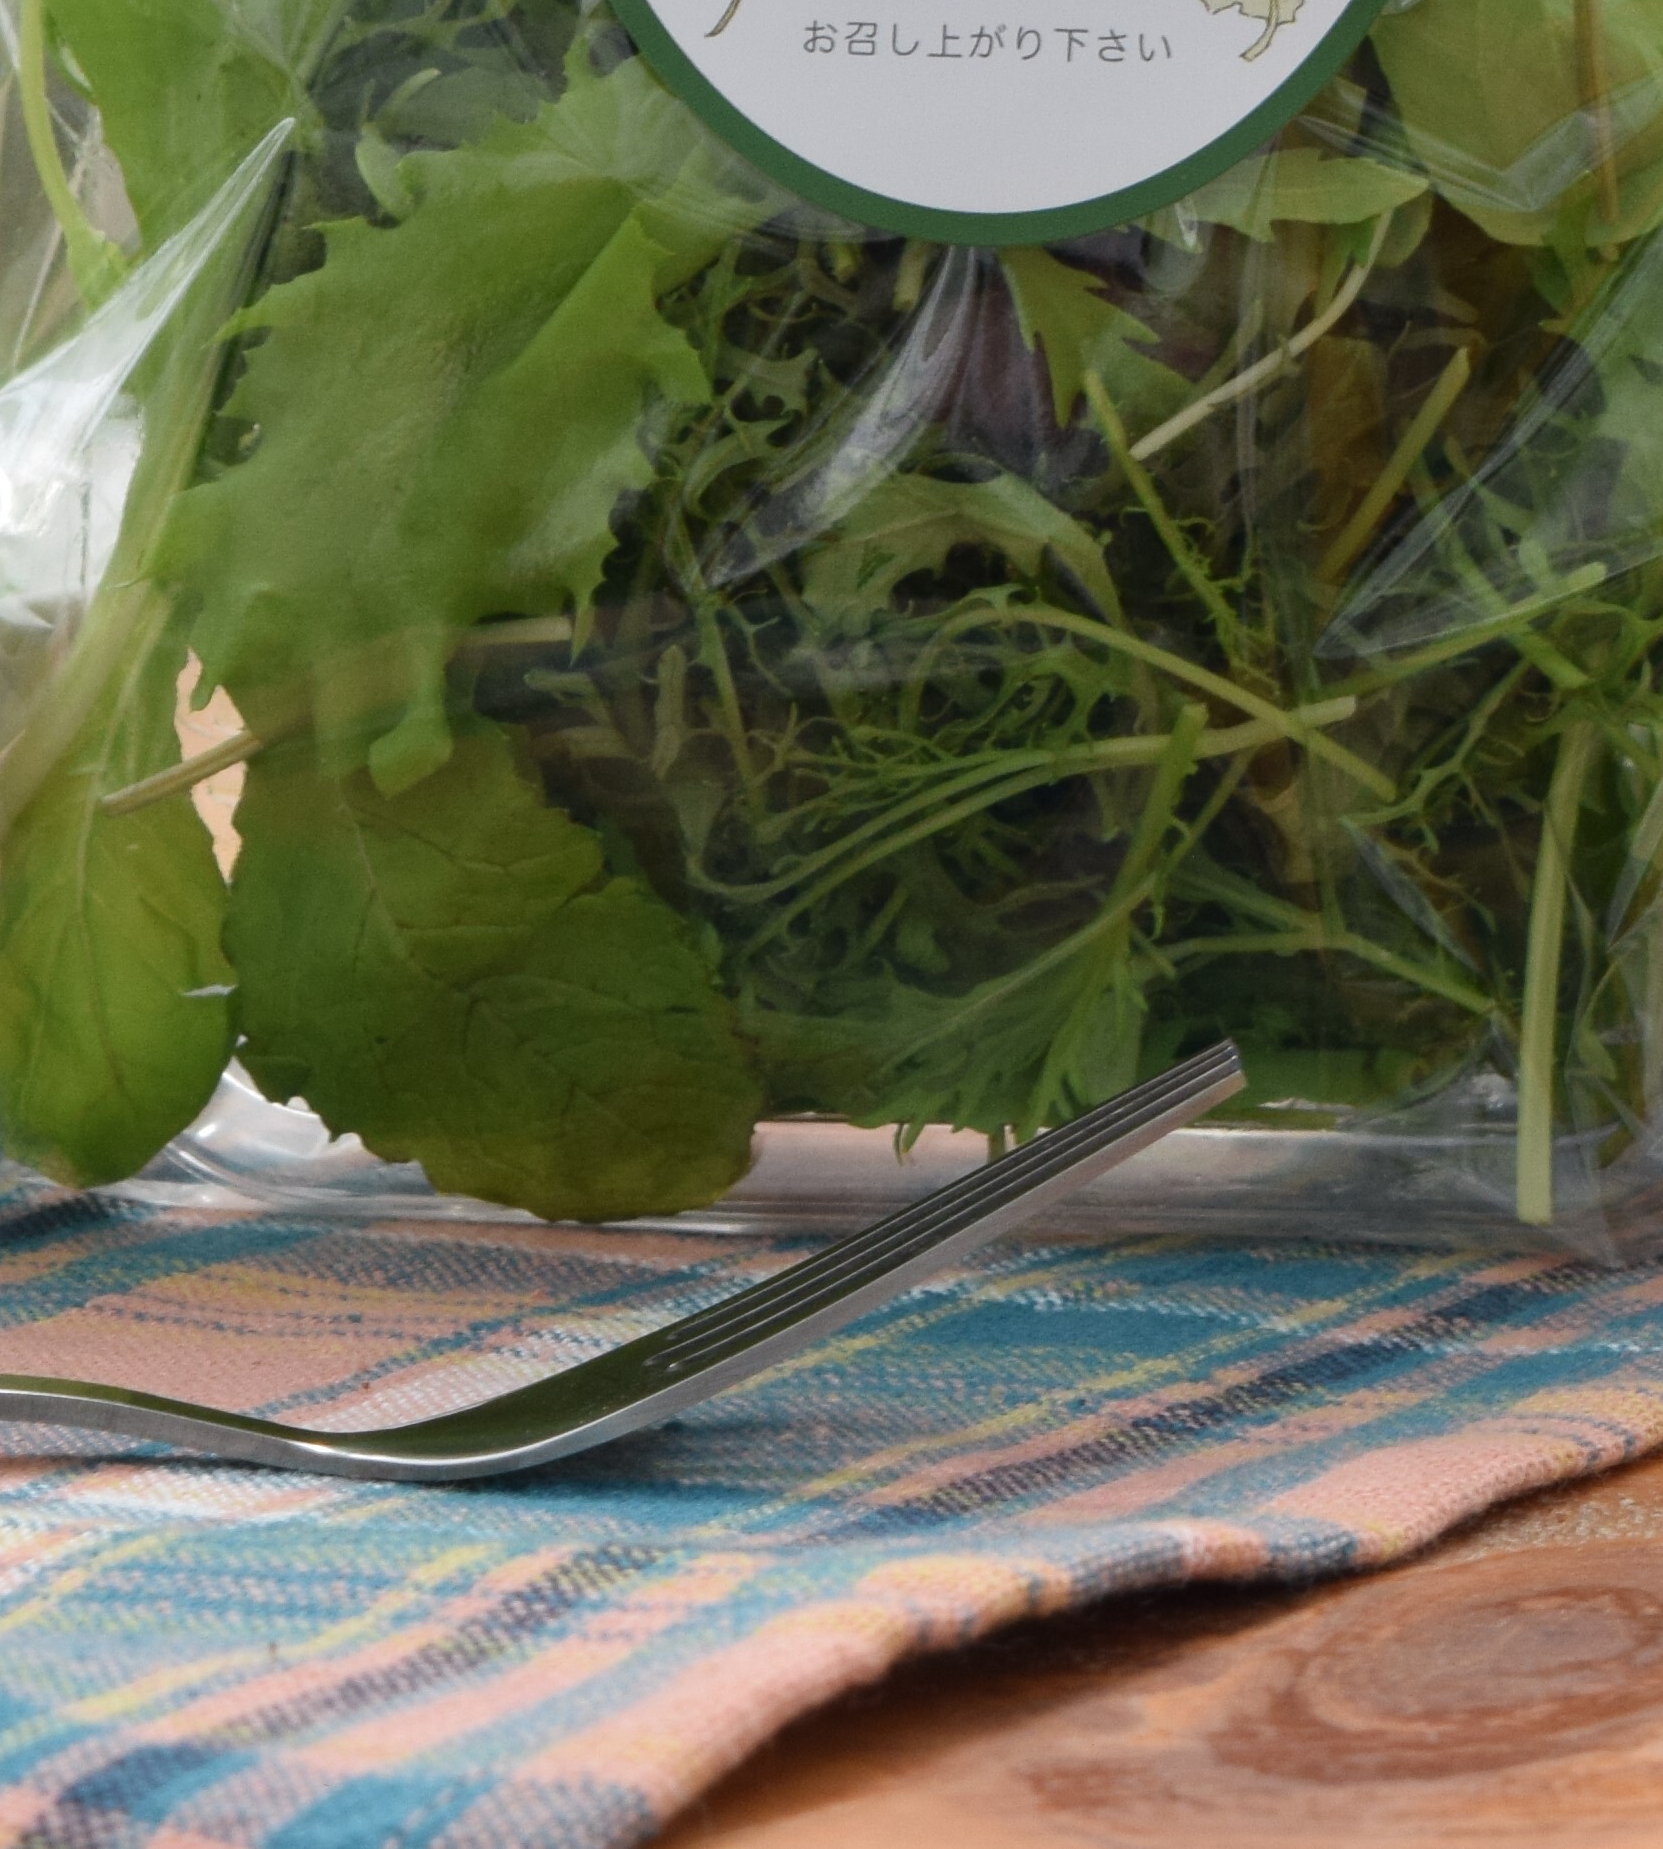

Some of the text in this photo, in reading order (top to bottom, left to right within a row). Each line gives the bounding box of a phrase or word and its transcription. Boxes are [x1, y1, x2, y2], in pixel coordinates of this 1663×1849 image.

[801, 19, 1173, 63] お召し上がり下さい
